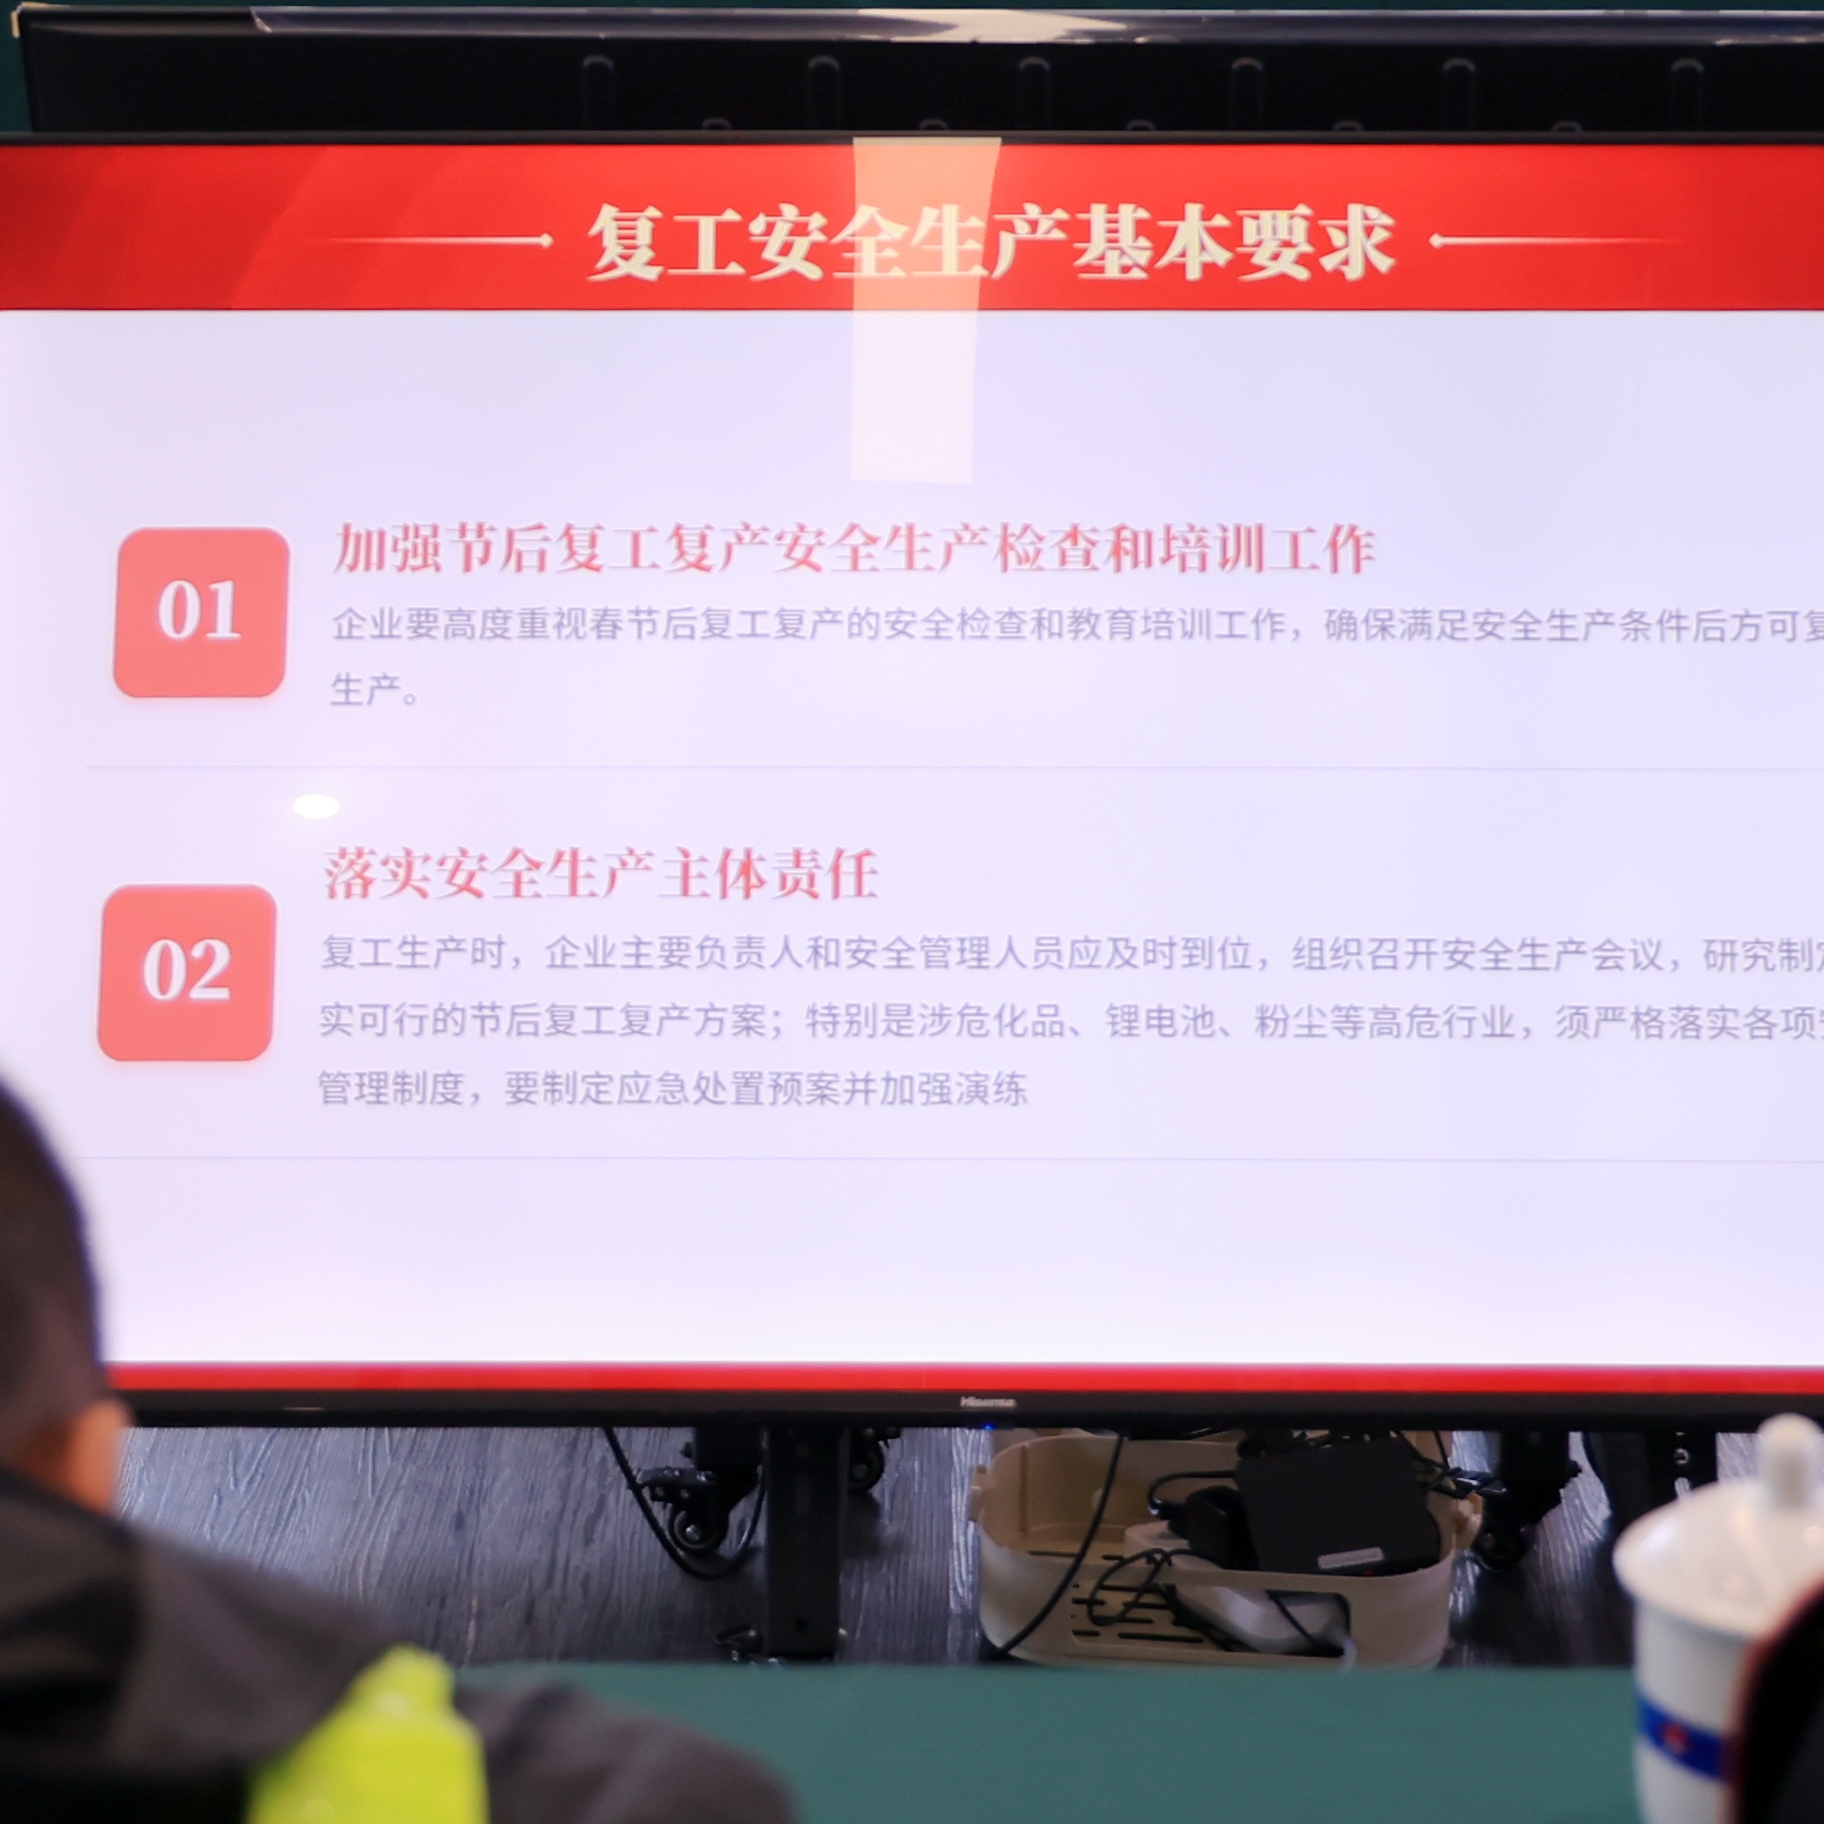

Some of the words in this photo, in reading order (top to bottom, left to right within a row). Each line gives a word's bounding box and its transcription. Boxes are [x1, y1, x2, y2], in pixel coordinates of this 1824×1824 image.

[586, 202, 1398, 283] 复工安全生产基本要求
[334, 520, 1378, 576] 加强节后复工复产安全生产检查和培训工作
[157, 579, 244, 640] 01
[324, 846, 880, 902] 落实安全生产主体责任
[142, 939, 233, 1001] 02
[318, 1069, 1030, 1109] 管理制度，要制定应急处置预案并加强演练
